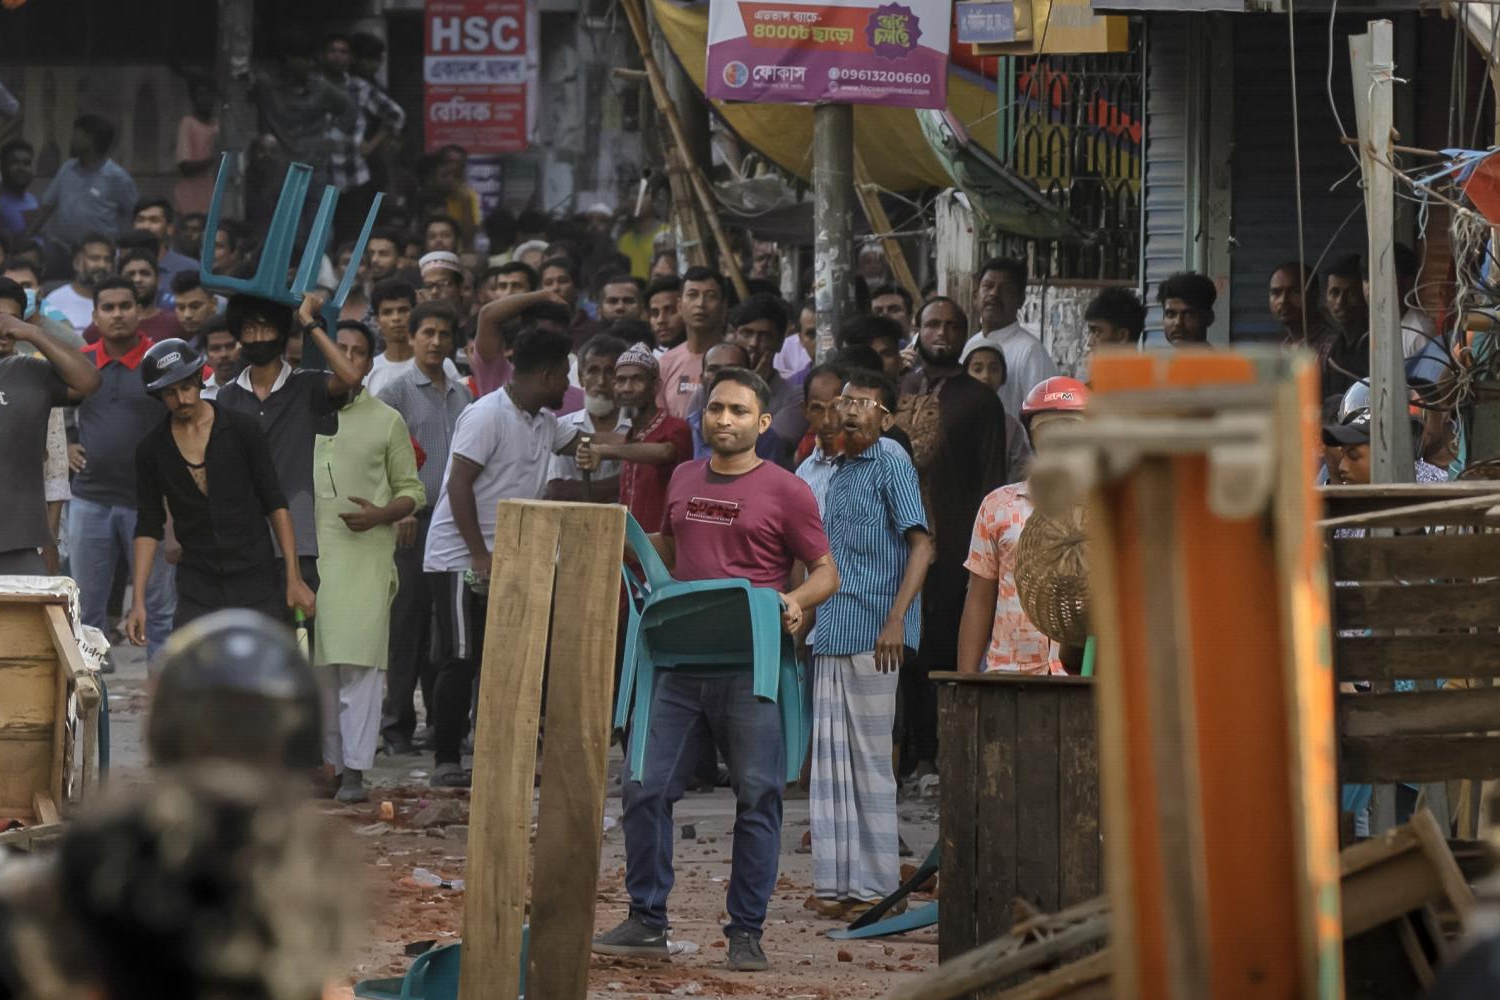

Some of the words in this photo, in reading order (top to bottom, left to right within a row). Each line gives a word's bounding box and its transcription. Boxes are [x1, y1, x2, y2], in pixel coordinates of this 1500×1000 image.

[432, 15, 519, 51] HSC
[752, 65, 807, 81] ফোকাস
[841, 69, 931, 84] 09613200600
